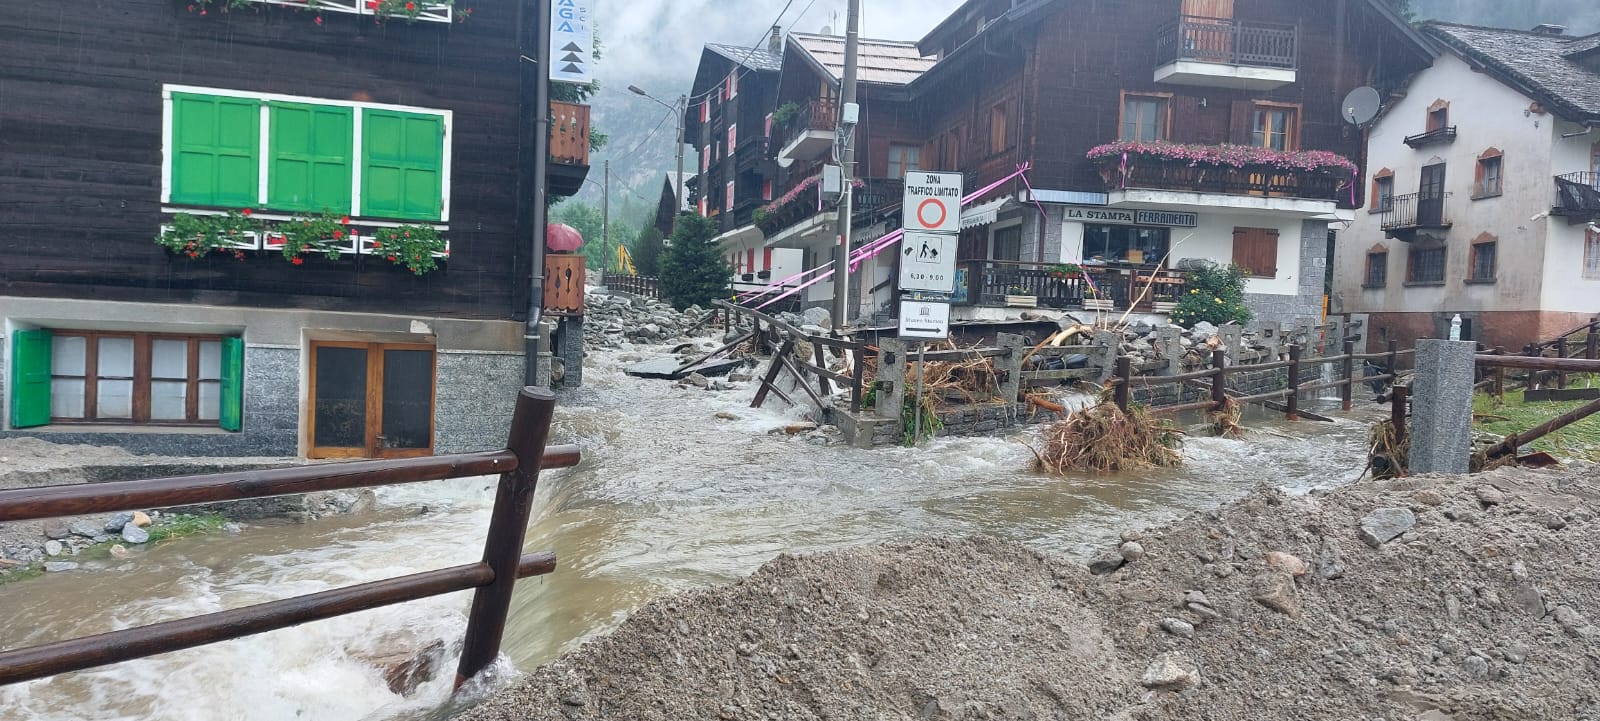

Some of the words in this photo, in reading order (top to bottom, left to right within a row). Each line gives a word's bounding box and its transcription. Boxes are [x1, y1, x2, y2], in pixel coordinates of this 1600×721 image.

[926, 174, 941, 184] ZONA
[907, 185, 933, 196] TRAFFICO
[934, 187, 959, 198] LIMITATO
[1068, 209, 1083, 218] LA
[1086, 210, 1132, 221] STAMPA
[1138, 211, 1195, 225] FERRAMENTA
